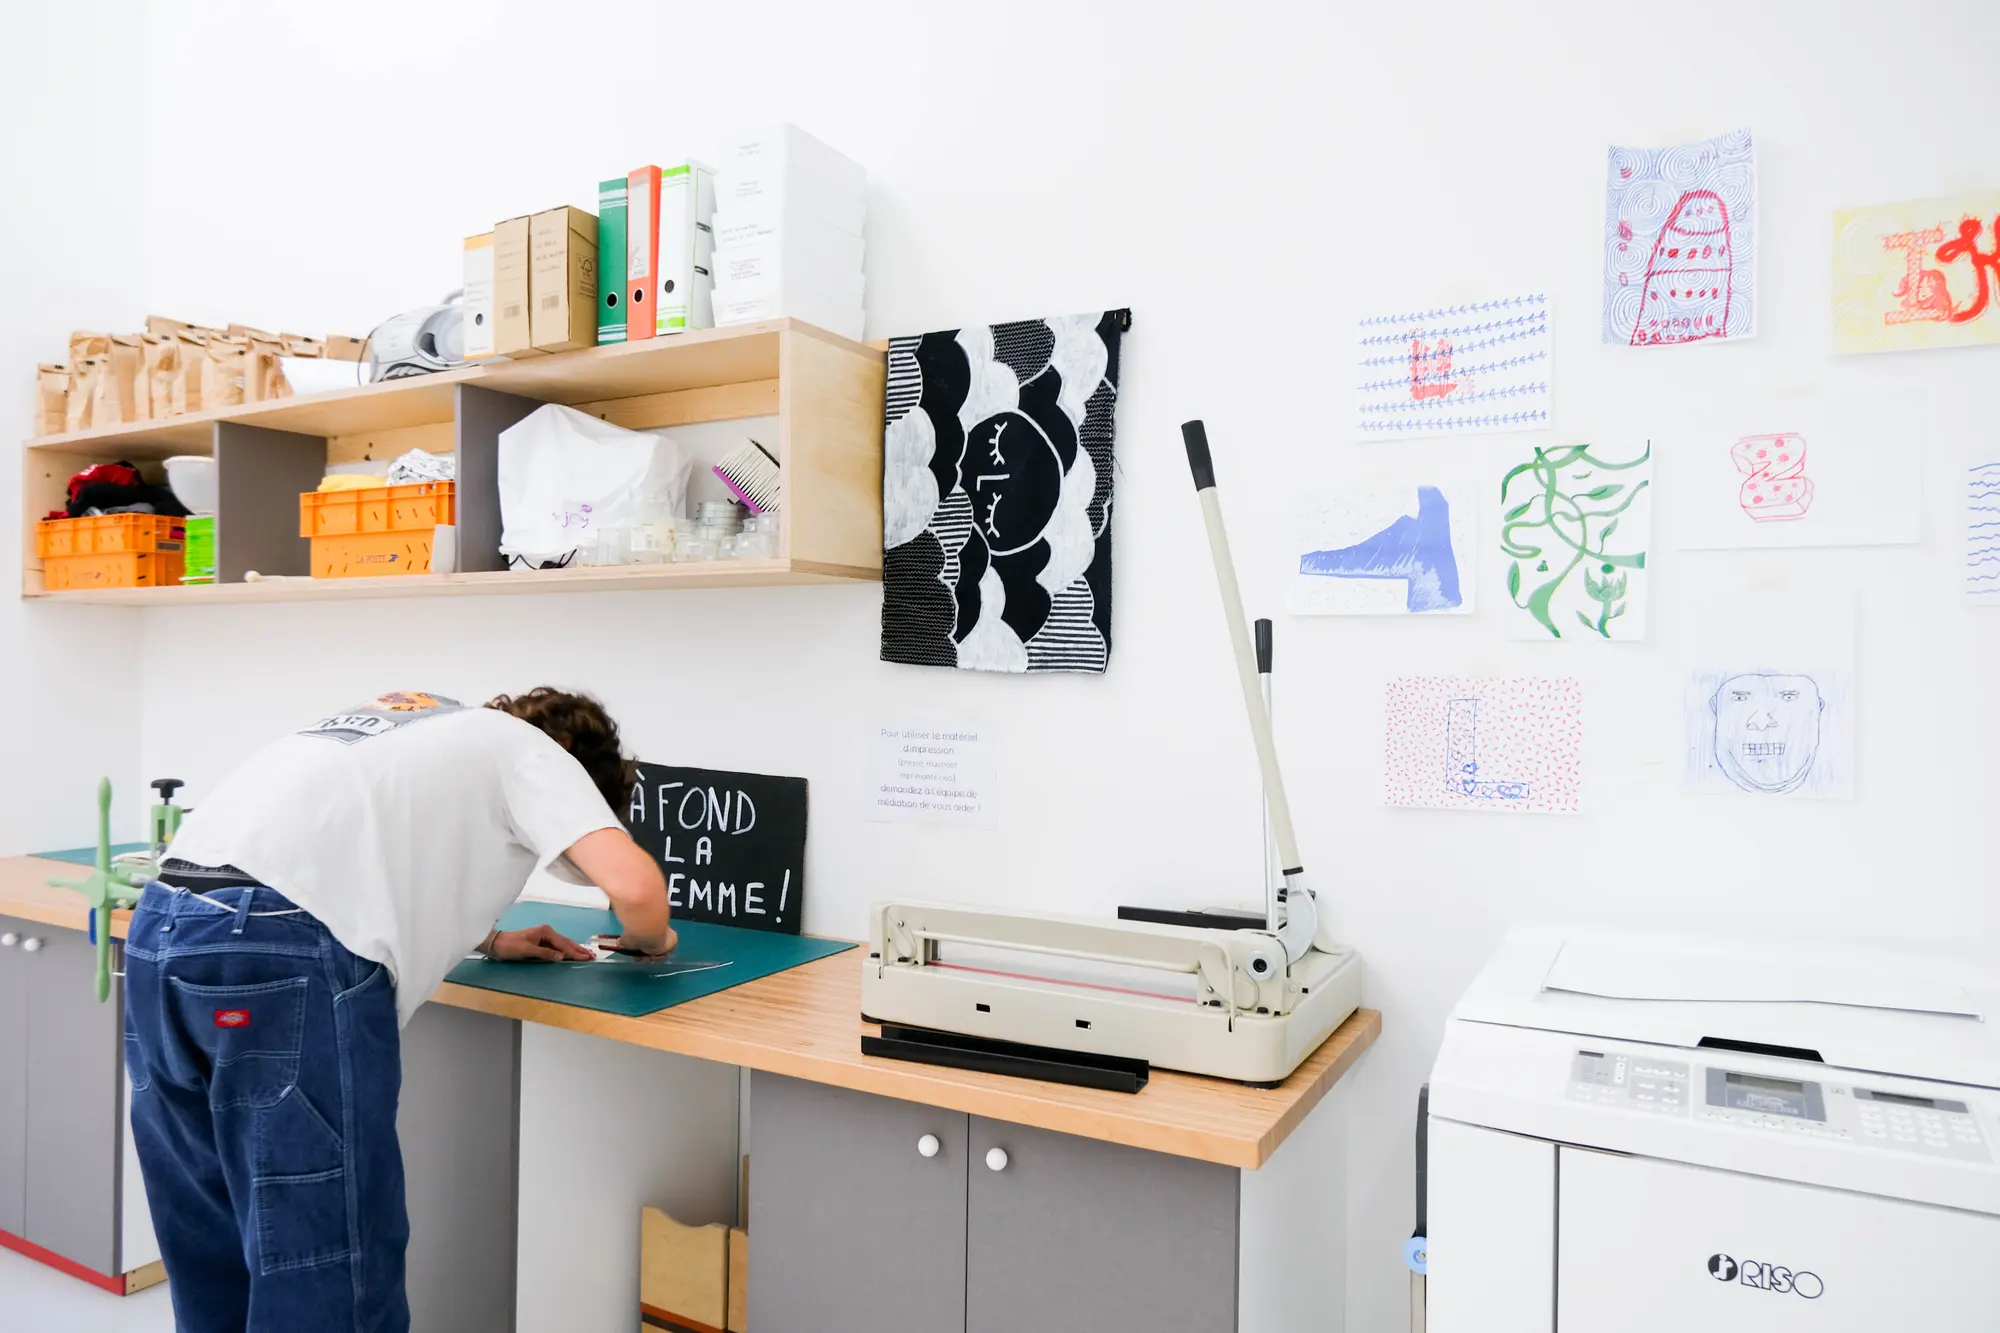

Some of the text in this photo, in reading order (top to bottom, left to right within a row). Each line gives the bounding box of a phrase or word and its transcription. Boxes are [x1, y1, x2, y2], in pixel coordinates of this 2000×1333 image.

[881, 728, 978, 741] Pour utiliser le matériel
[629, 769, 756, 836] À FOND
[877, 798, 917, 808] médiation
[919, 800, 930, 809] de
[931, 803, 951, 811] vous
[953, 803, 975, 812] aider
[880, 783, 923, 795] demandez
[966, 789, 978, 799] de
[665, 835, 713, 866] LA
[668, 868, 791, 923] EMME!
[1740, 1259, 1824, 1299] RISO
